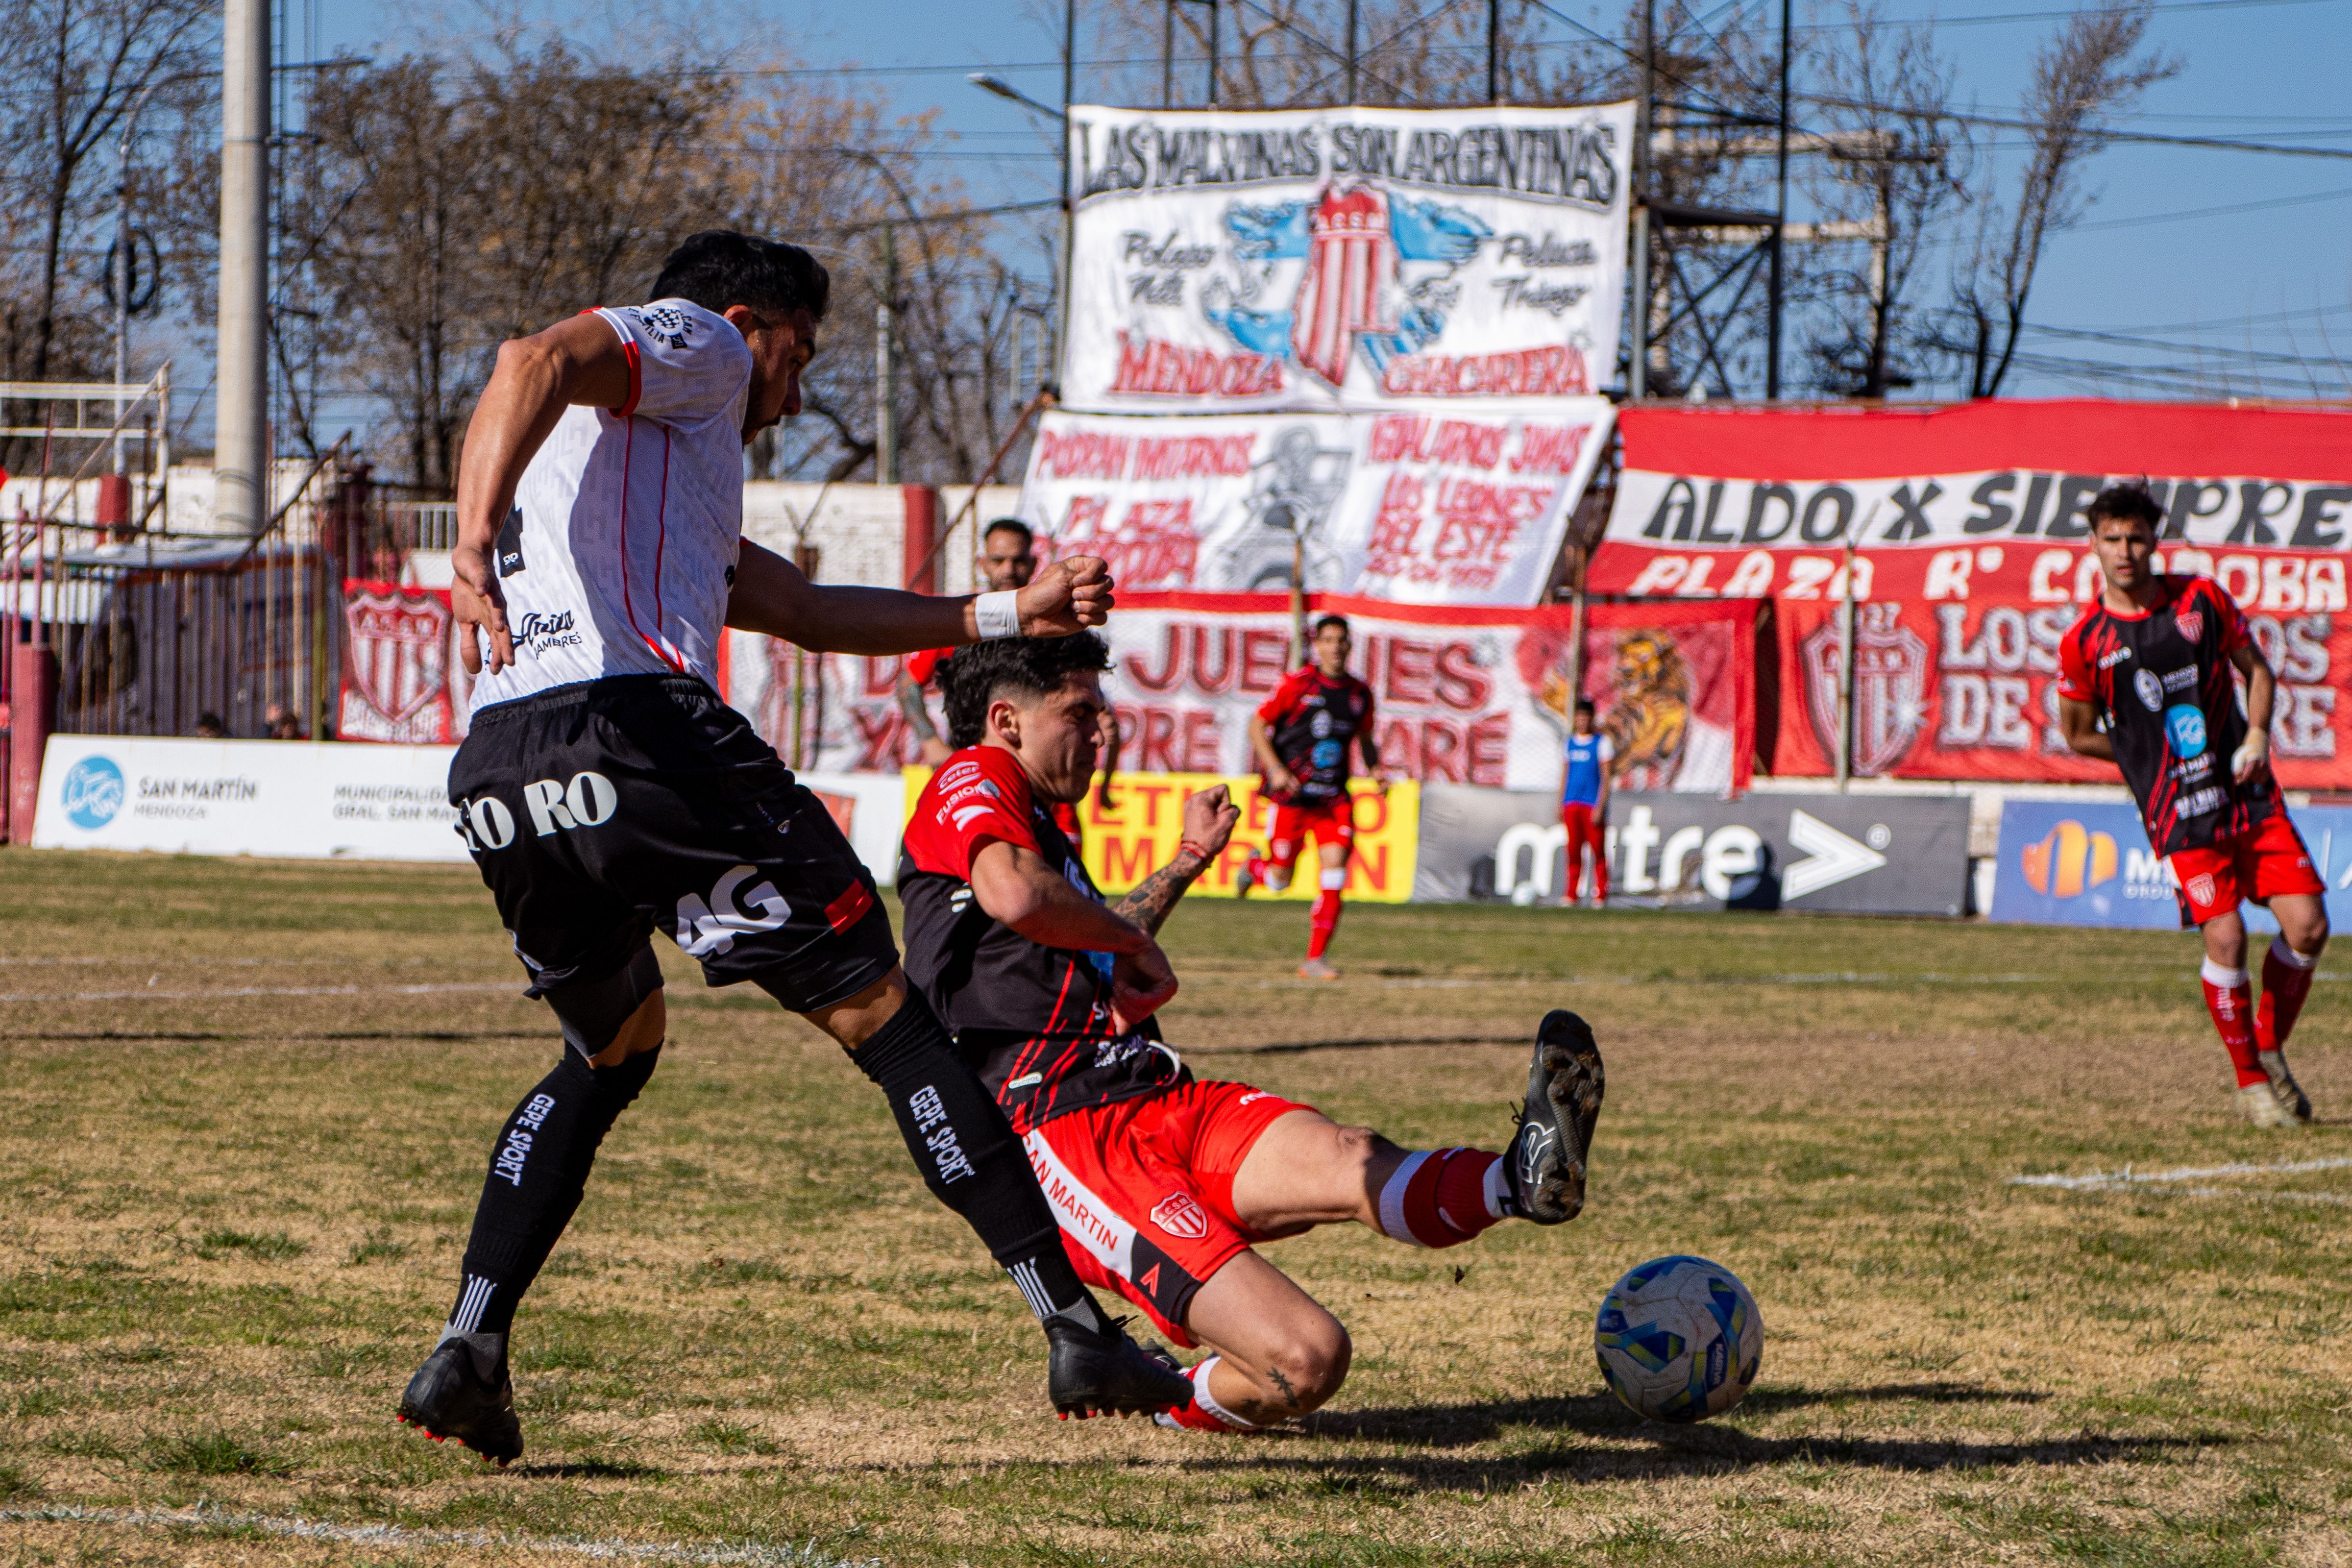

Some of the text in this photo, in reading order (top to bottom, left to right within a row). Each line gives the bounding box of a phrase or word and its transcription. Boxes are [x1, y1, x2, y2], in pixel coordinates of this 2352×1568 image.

[1079, 122, 1616, 204] LAS MALVINAS SON ARGENTINAS
[1106, 327, 1283, 396] MENDOZA
[1385, 344, 1590, 397] CHACARERA
[1066, 495, 1193, 537] PLAZA
[1435, 476, 1552, 520] LEONES
[1642, 470, 2352, 549] ALDO X SIEPRE
[1367, 517, 1518, 563] DEL ESTE
[1626, 550, 1876, 601] PLAZA
[1123, 622, 1492, 711] JUEES
[2098, 645, 2132, 671] mitre
[1939, 675, 2032, 749] DE
[133, 804, 207, 820] MENDOZA
[138, 773, 258, 802] SAN MARTÍN
[388, 806, 420, 823] SAN
[493, 1093, 556, 1186] GEPE SPORT
[909, 1084, 976, 1185] GEPE SPORT
[1048, 1176, 1119, 1252] MARTIN
